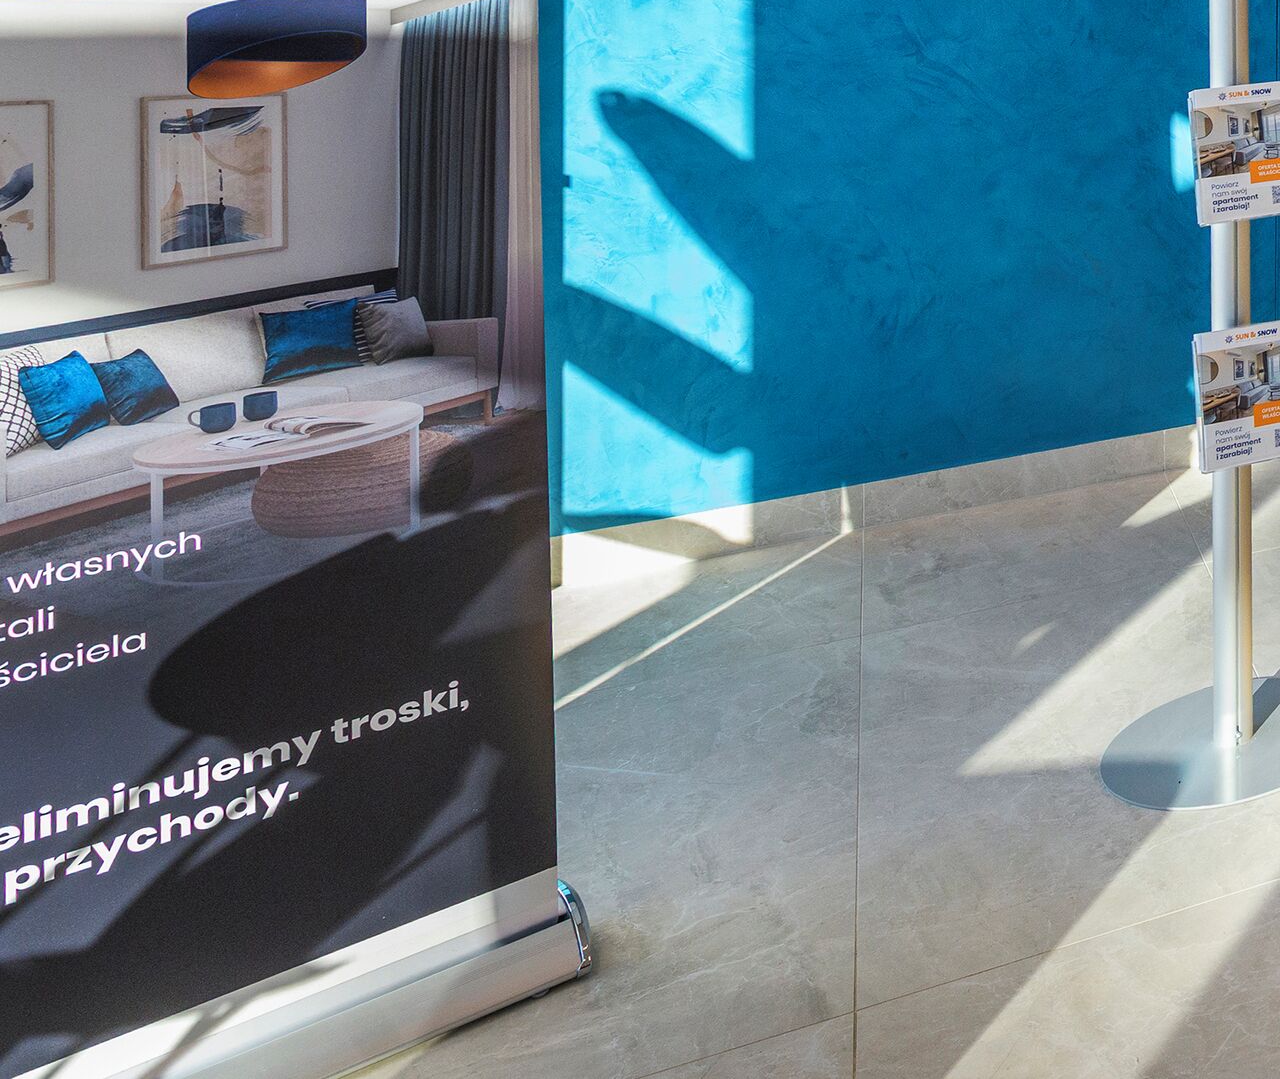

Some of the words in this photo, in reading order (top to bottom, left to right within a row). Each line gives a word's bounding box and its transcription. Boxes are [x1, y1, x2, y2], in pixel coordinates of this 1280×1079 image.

[1251, 88, 1271, 96] SNOW
[1211, 181, 1239, 190] Powierz
[1231, 187, 1247, 195] swój
[1212, 194, 1259, 206] apartament
[1217, 202, 1250, 213] zarabiaj!
[1257, 328, 1277, 337] SNOW
[1215, 426, 1243, 436] Powierz
[1234, 432, 1250, 441] swój
[1216, 438, 1261, 453] apartament
[1220, 447, 1253, 459] zarabiaj!
[7, 531, 201, 593] własnych
[0, 730, 321, 852] eliminujemy
[331, 680, 470, 744] troski,
[5, 780, 299, 906] przychody.
